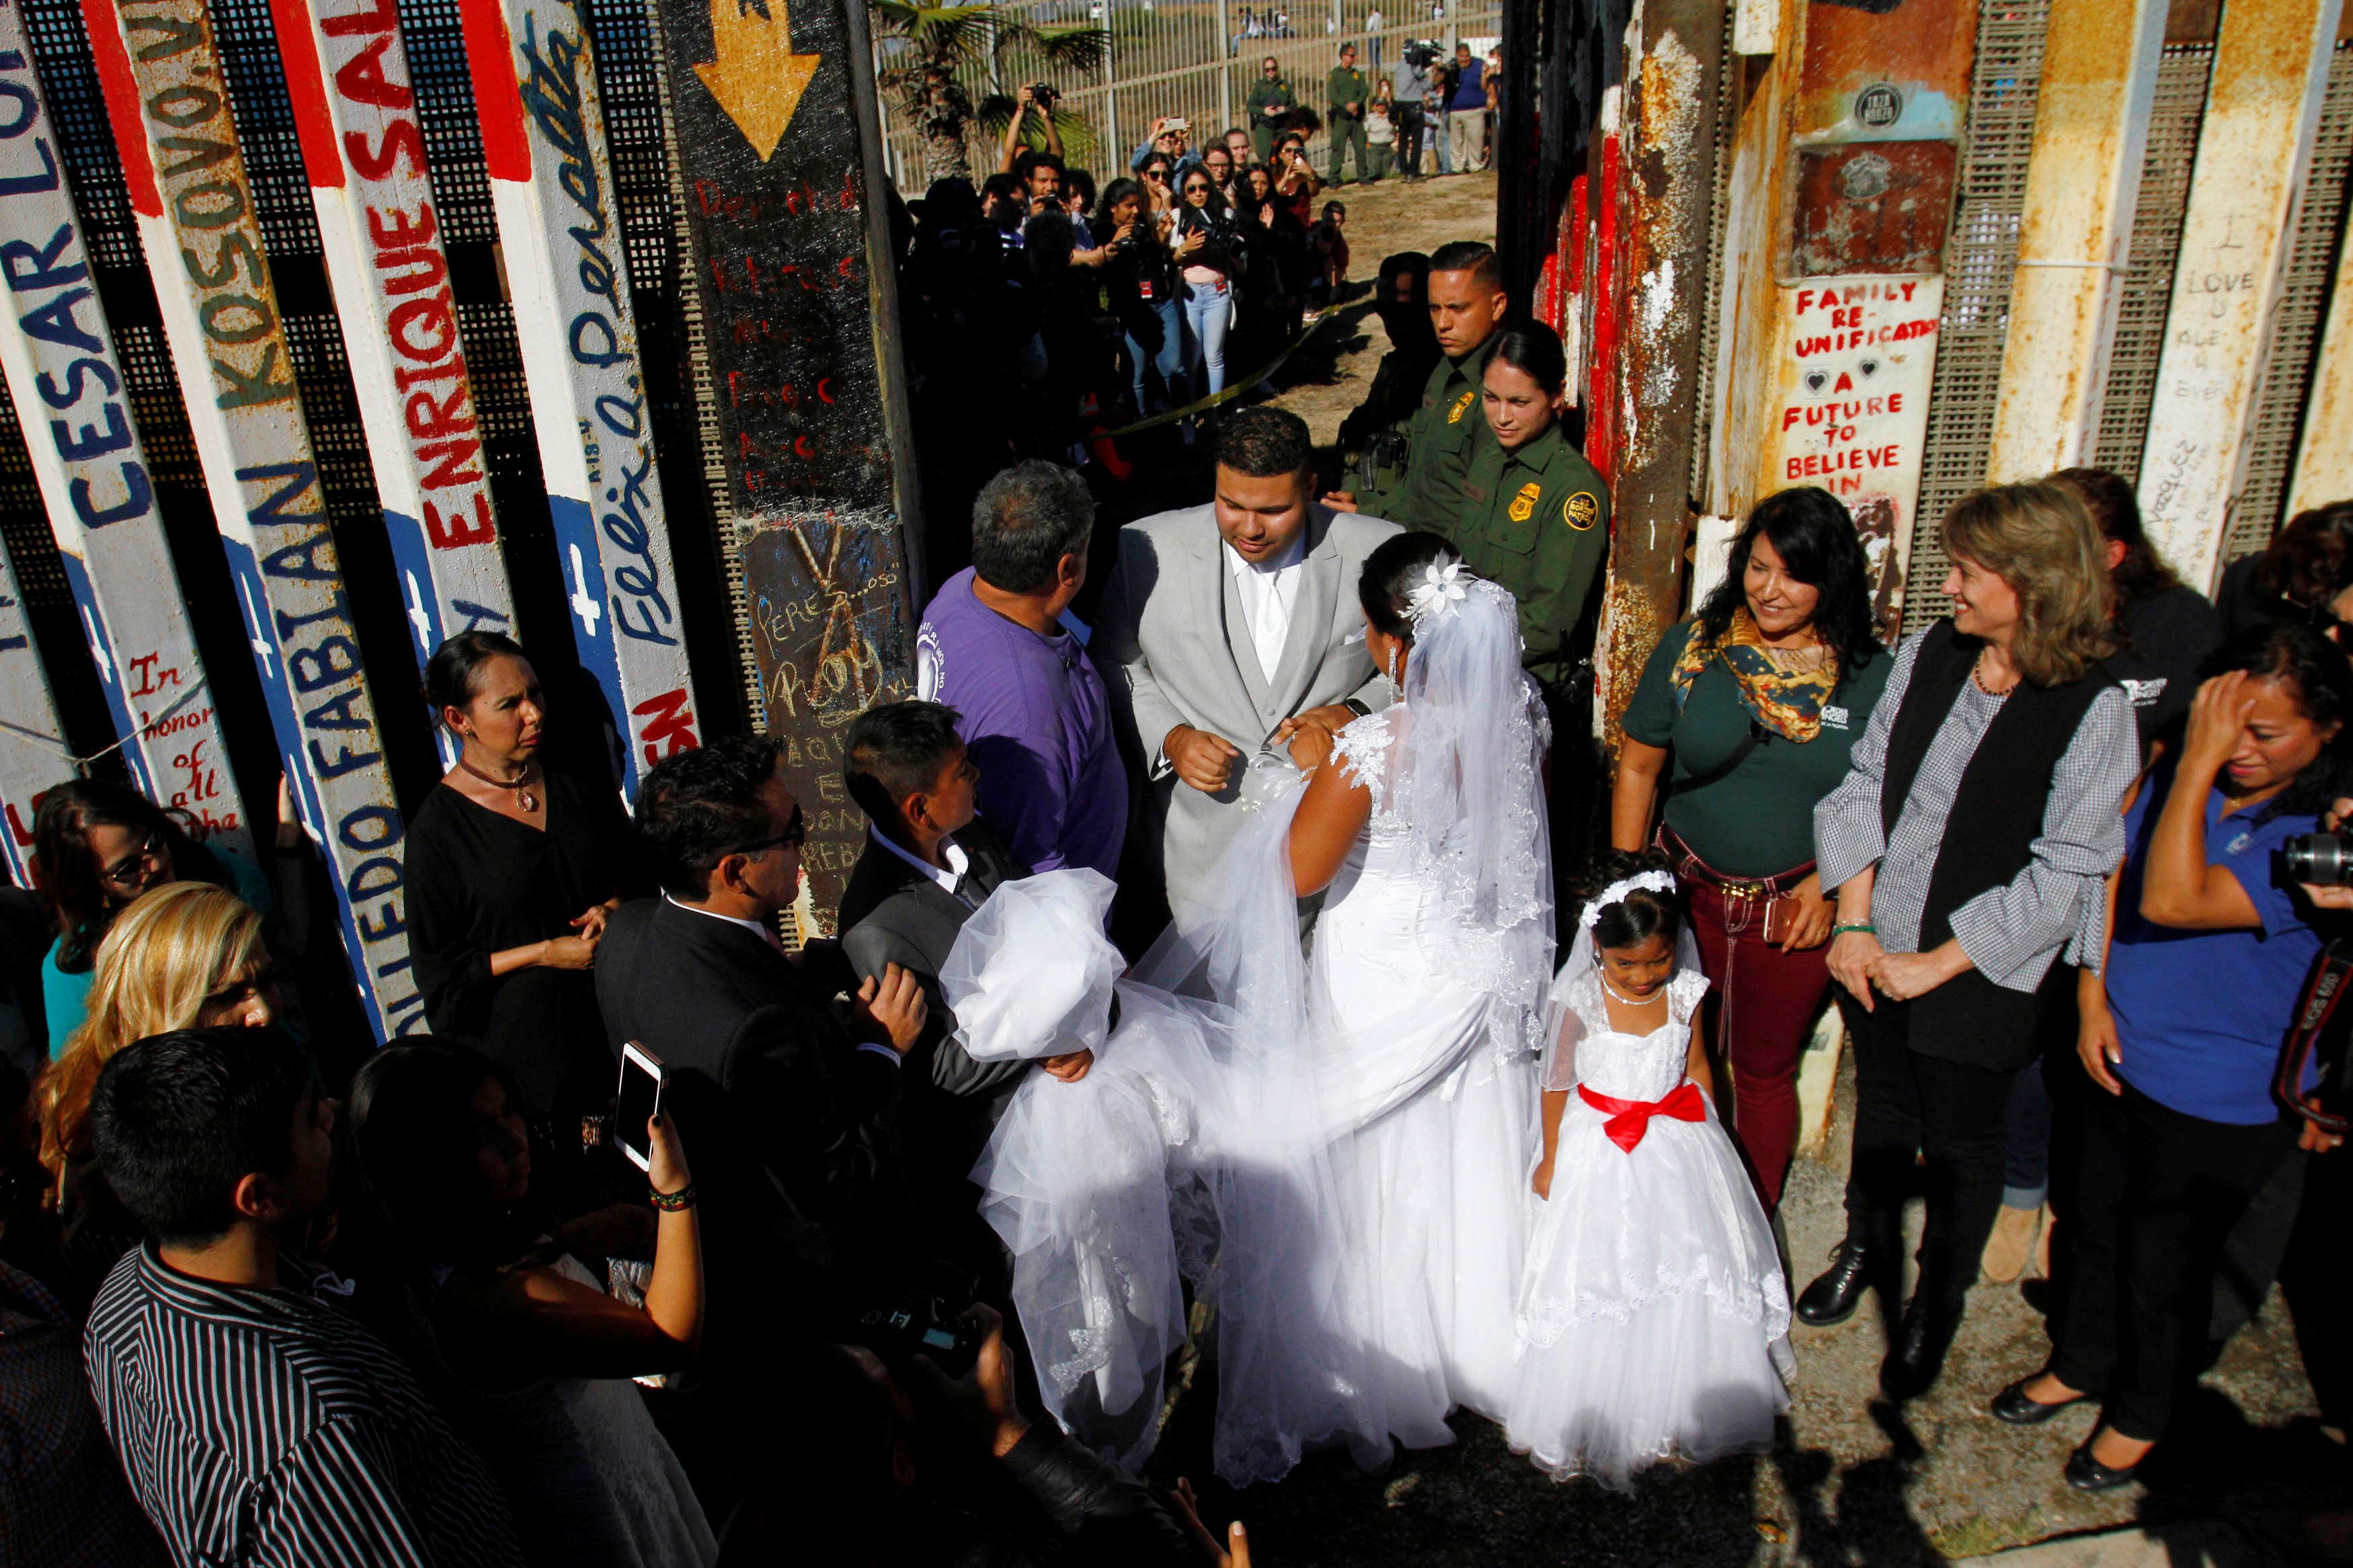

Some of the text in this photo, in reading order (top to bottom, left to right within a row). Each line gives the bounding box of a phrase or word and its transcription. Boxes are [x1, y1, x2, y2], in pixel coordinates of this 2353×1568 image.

[1796, 282, 1917, 315] FAMILY
[2188, 271, 2255, 294] LOVE
[0, 222, 153, 530] CESAR
[367, 202, 496, 550] ENRIQUE
[1834, 372, 1853, 394] A
[1782, 393, 1903, 432] FUTURE
[1823, 425, 1856, 448] TO
[1787, 444, 1900, 479] BELIEVE
[1829, 472, 1862, 495] IN
[603, 444, 679, 647] Felix
[235, 460, 383, 781] FABIAN
[130, 650, 182, 699] In
[140, 707, 214, 741] honor
[173, 739, 207, 790] of
[171, 768, 220, 808] all
